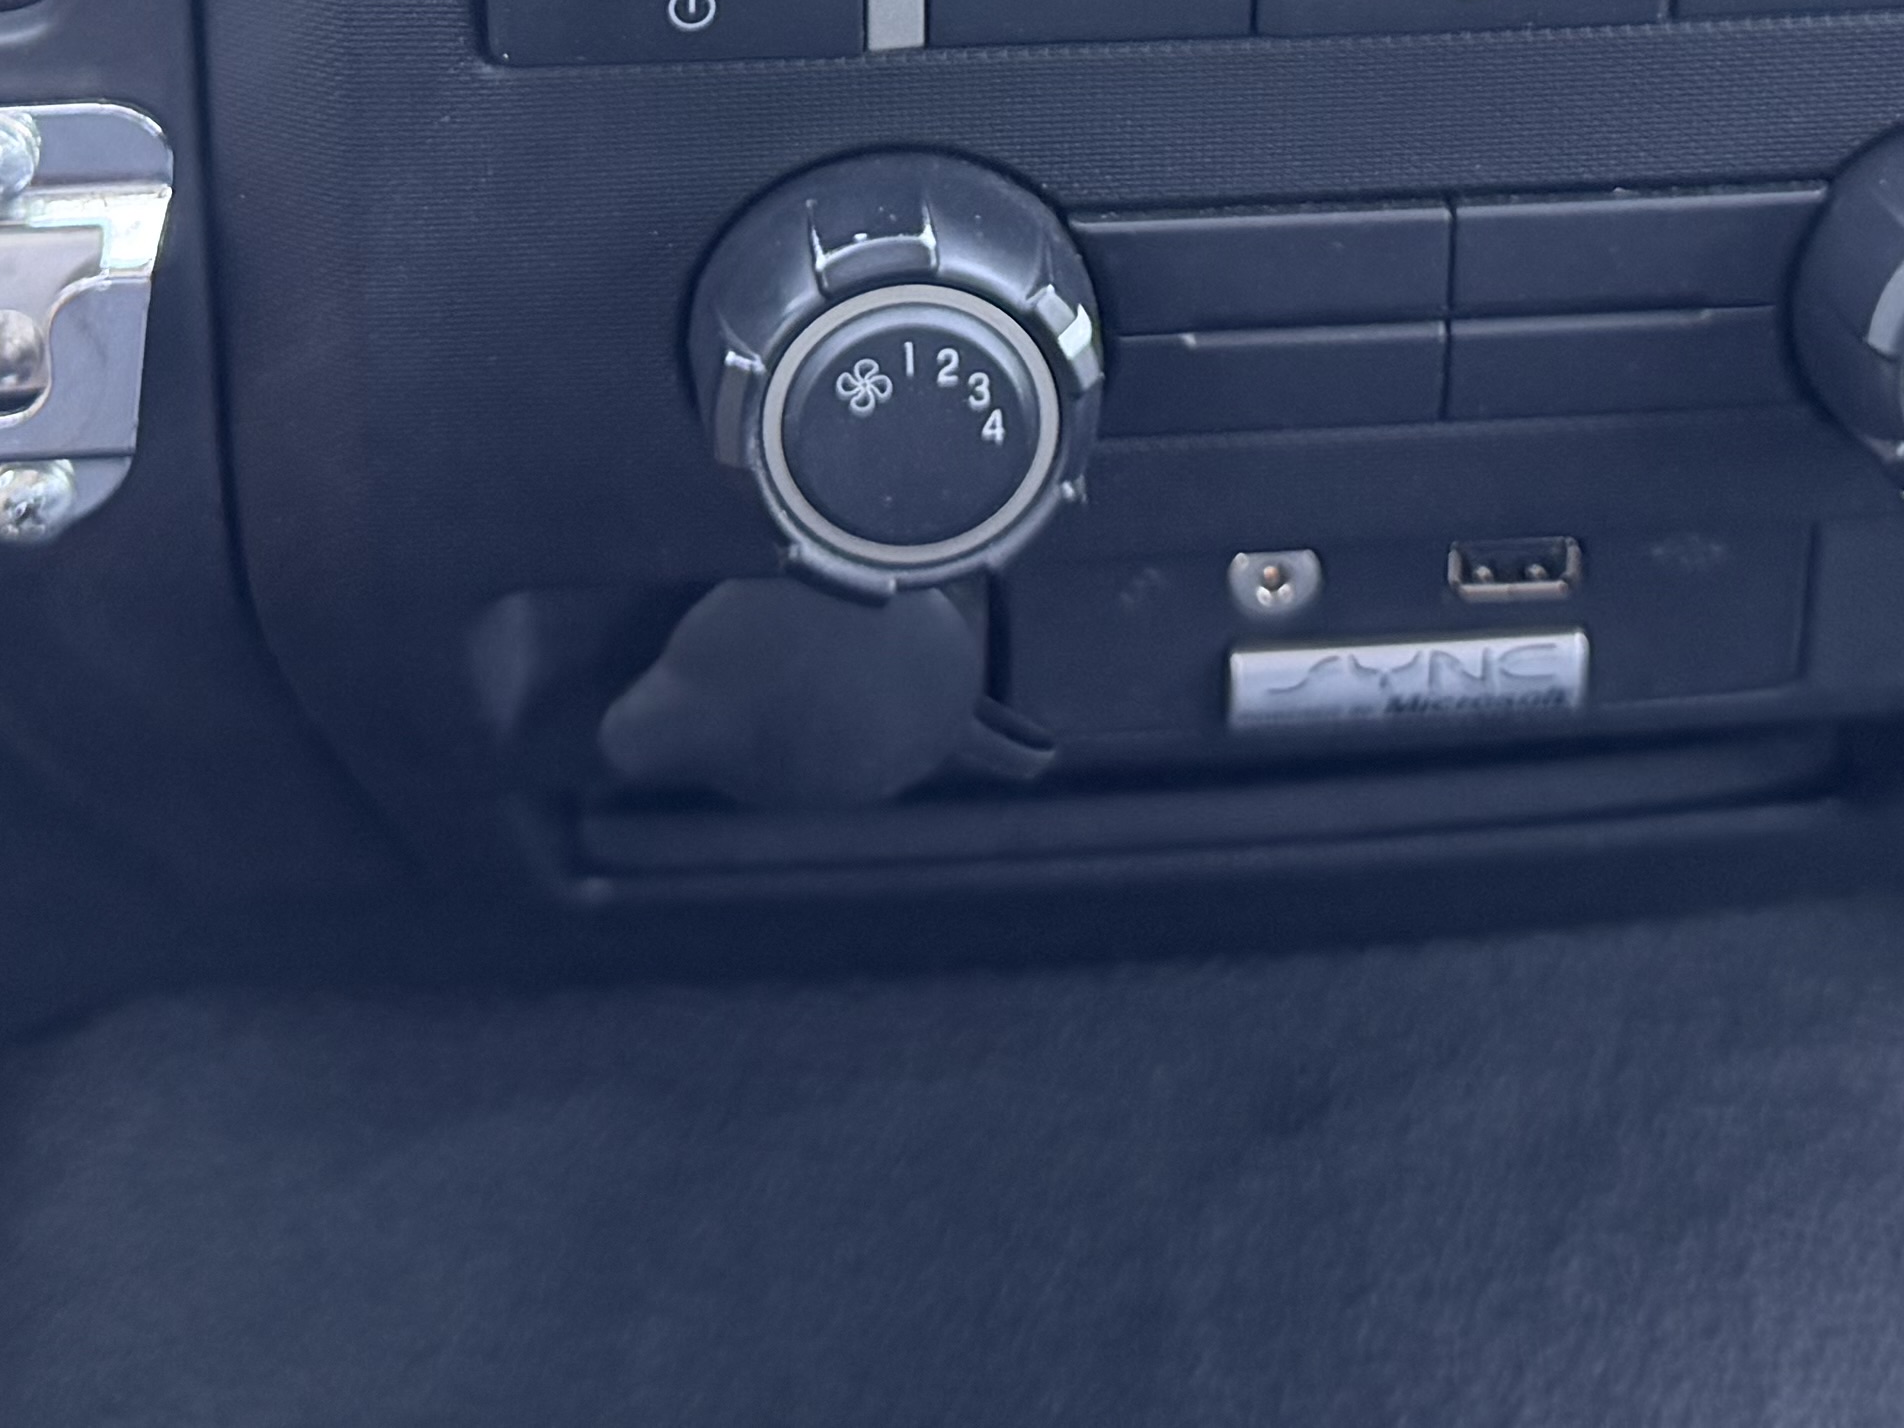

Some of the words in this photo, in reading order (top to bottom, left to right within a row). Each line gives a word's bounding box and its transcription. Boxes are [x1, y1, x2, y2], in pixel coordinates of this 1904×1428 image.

[904, 341, 914, 377] 1
[936, 347, 959, 387] 2
[967, 371, 991, 411] 3
[981, 408, 1006, 445] 4
